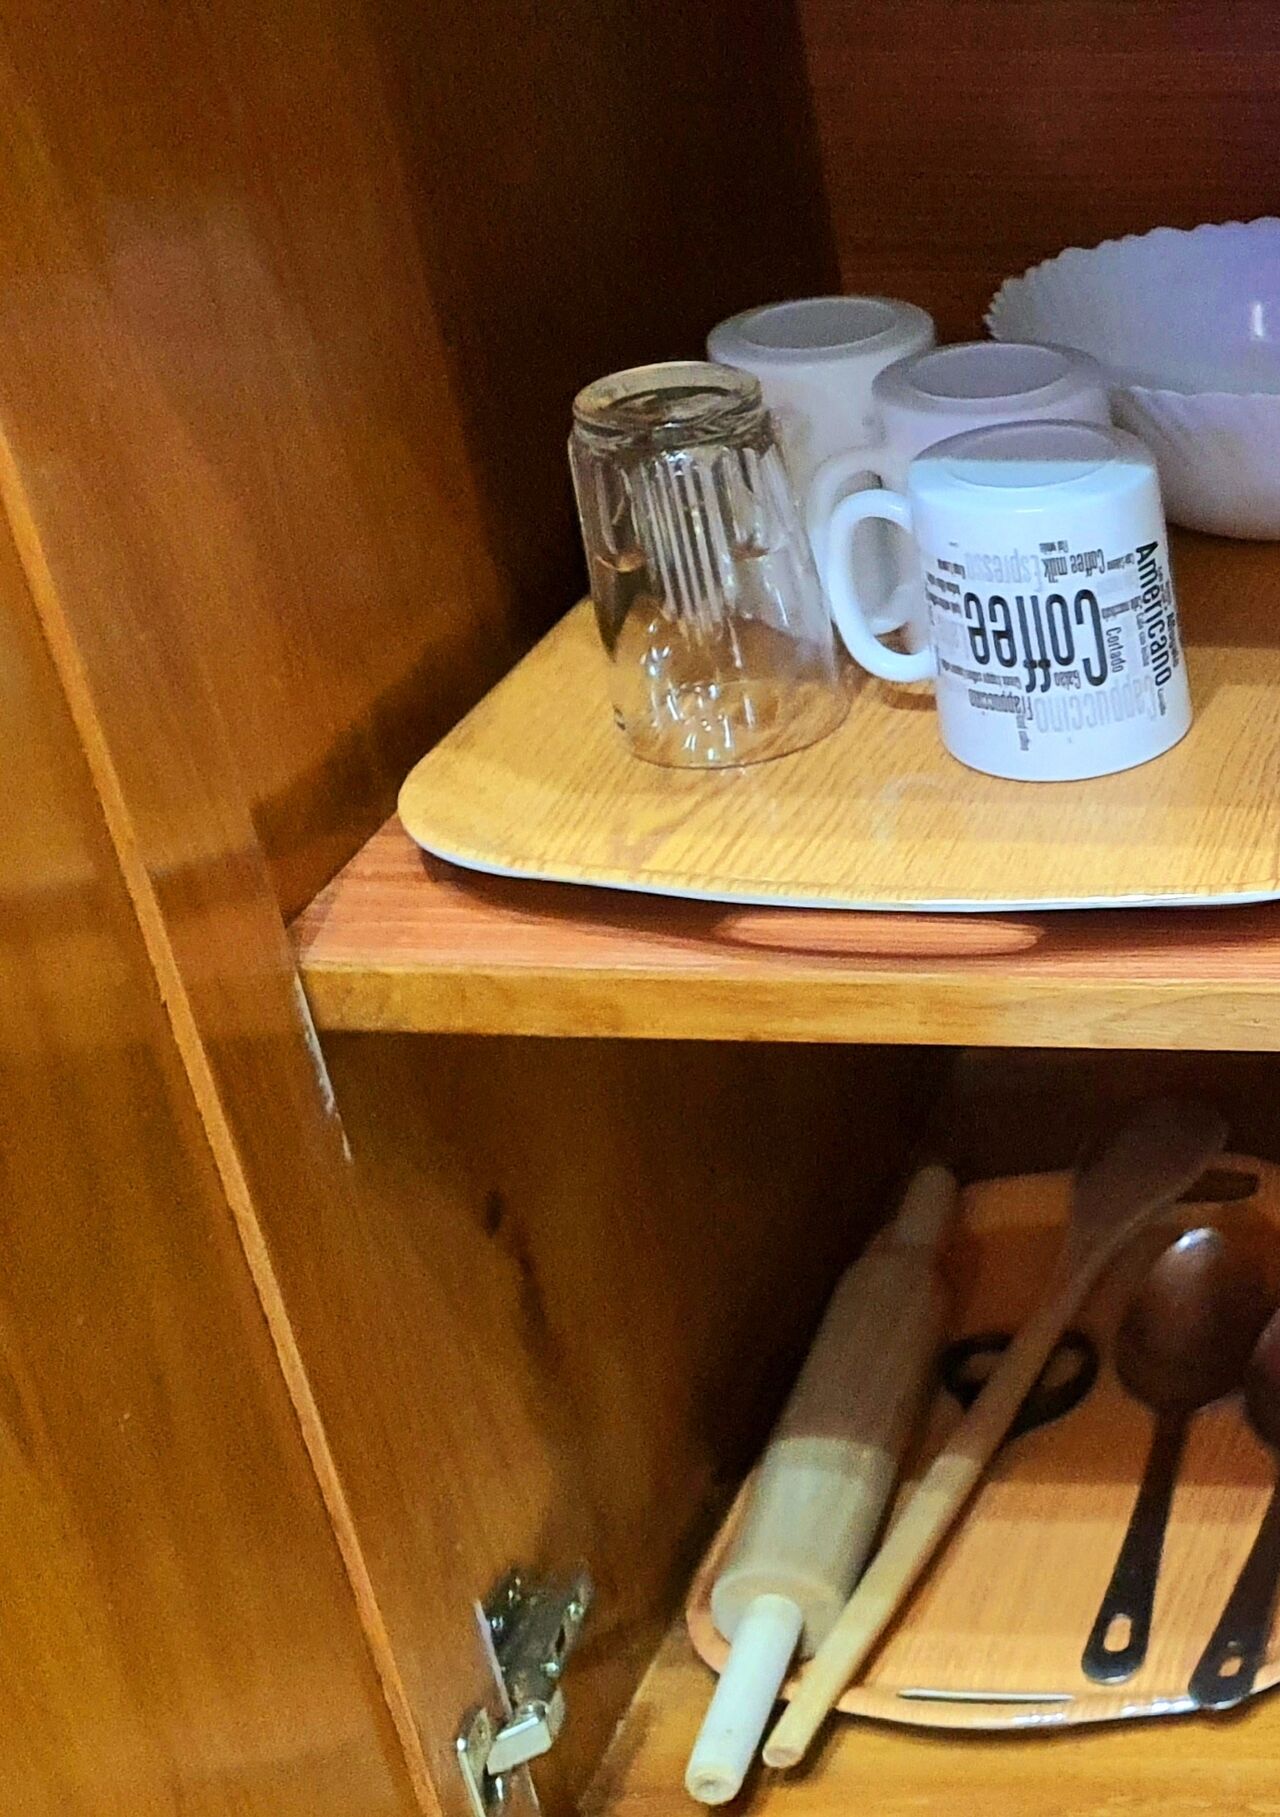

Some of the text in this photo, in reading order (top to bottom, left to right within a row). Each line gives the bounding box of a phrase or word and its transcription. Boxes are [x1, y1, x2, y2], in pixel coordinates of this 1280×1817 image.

[1069, 547, 1105, 583] Coffee
[963, 589, 1109, 694] Coffee
[1136, 540, 1172, 687] Americano
[1034, 674, 1157, 733] Cappuccino
